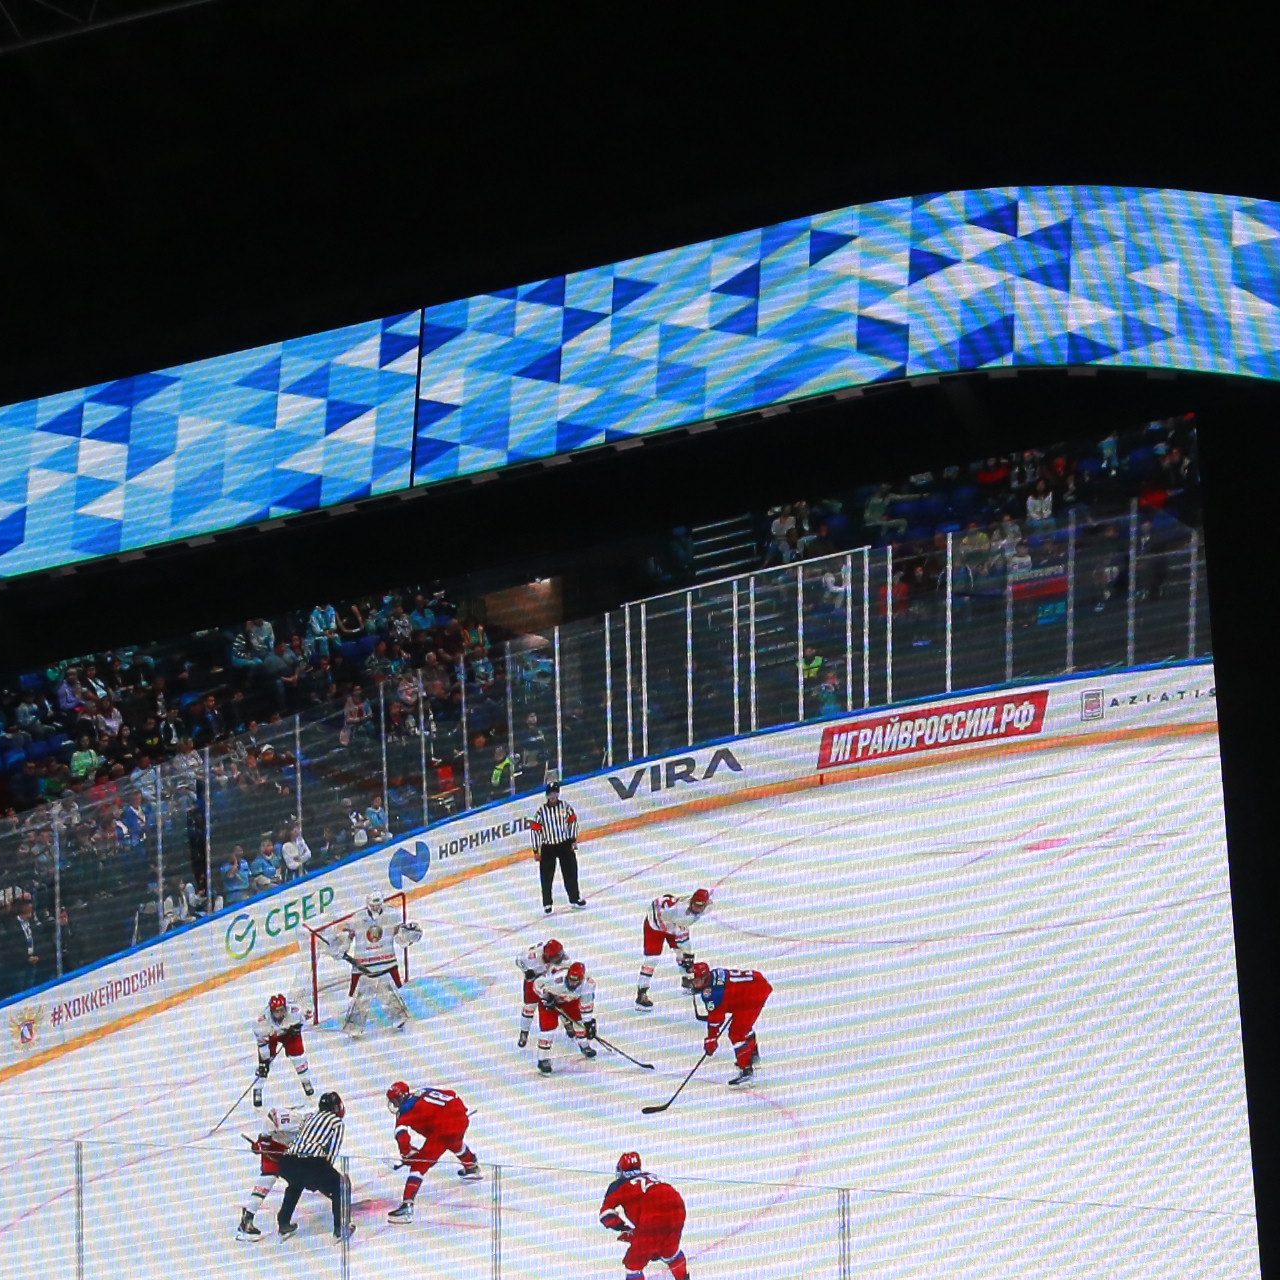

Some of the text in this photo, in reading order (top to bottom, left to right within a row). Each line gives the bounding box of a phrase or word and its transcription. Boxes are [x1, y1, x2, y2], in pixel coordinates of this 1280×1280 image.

[829, 700, 1036, 764] ИГРАЙВРОССИИ.РФ
[607, 747, 744, 801] VIRA
[438, 817, 532, 860] НОРНИКЕЛЬ
[264, 886, 335, 937] СБЕР
[50, 961, 165, 1028] #ХОККЕЙРОССИИ
